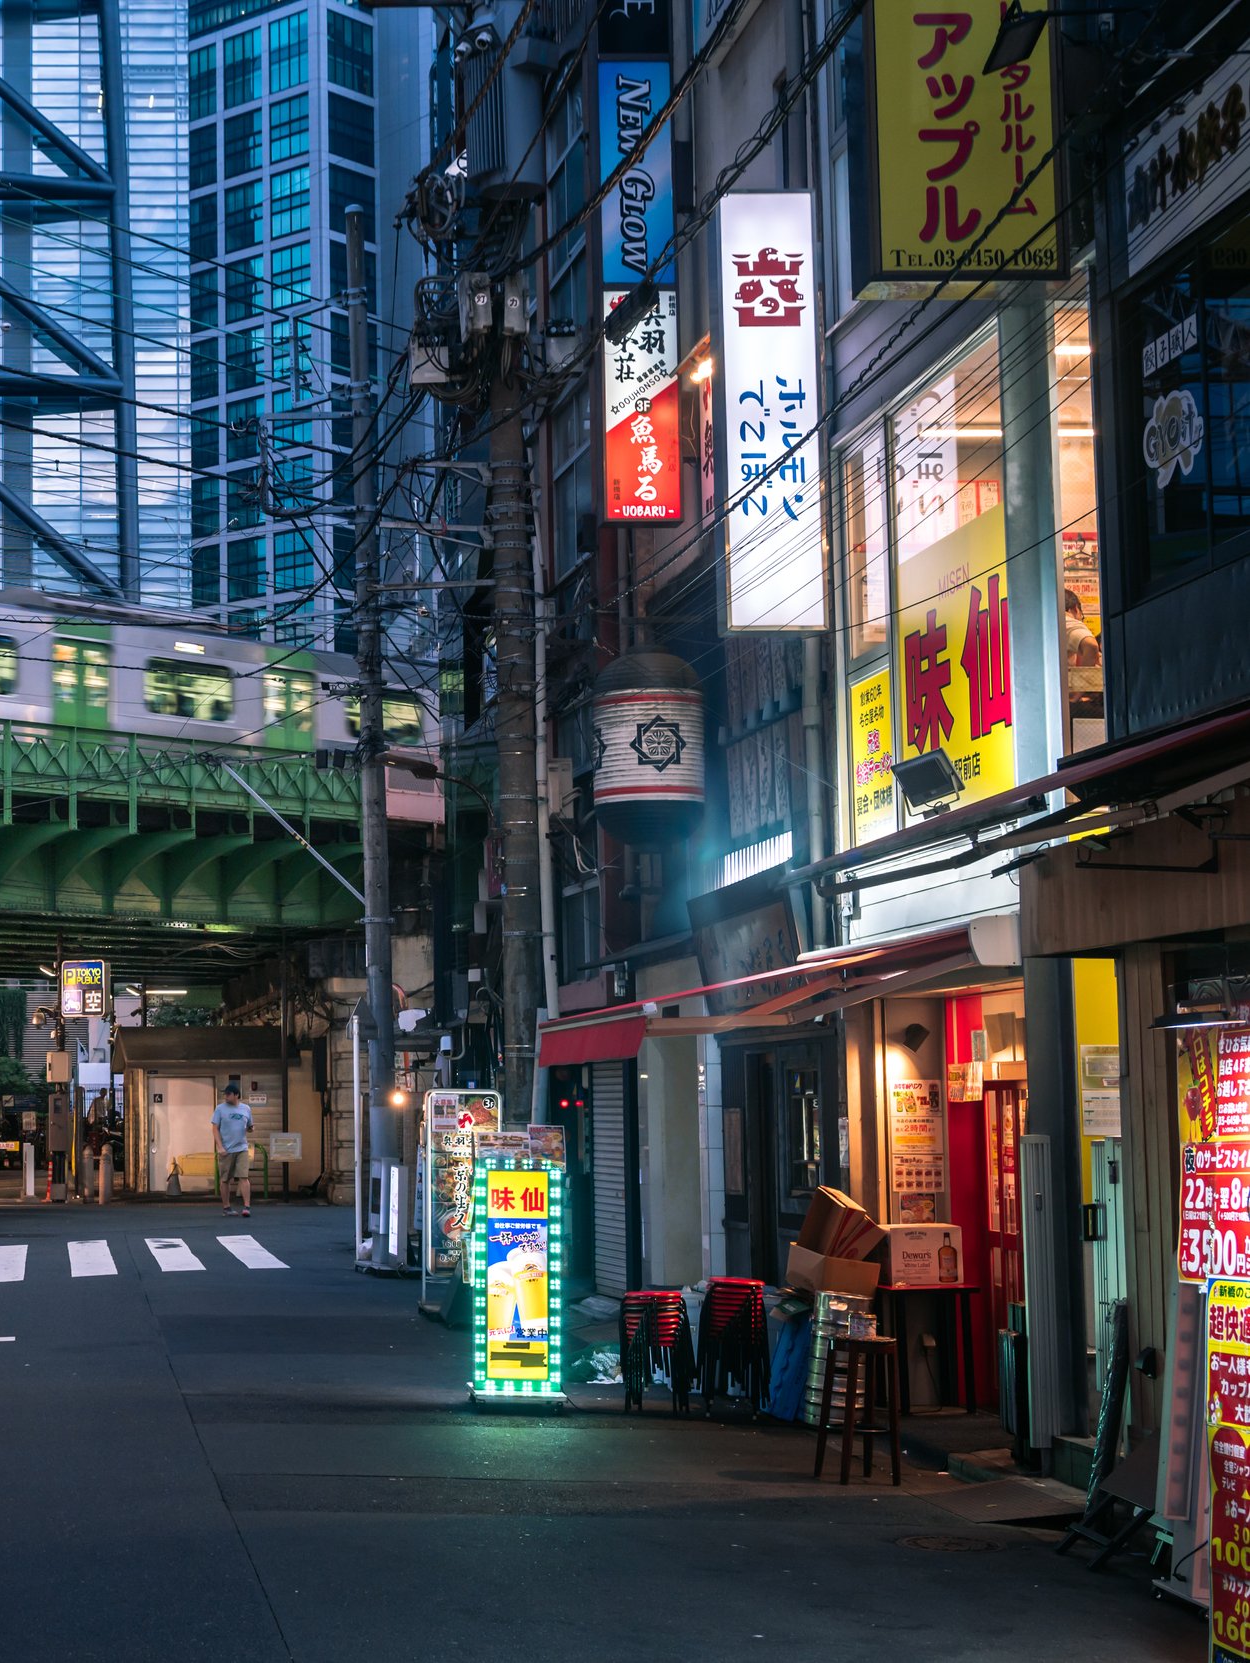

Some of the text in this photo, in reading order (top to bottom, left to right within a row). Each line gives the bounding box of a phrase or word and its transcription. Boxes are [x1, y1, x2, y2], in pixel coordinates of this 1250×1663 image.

[1000, 0, 1038, 216] タルルーム
[913, 13, 982, 243] アップル
[621, 167, 652, 272] GLOW
[890, 248, 1054, 268] TEL.0364501069
[636, 399, 651, 412] 3F
[739, 379, 773, 517] でこぼこ
[776, 374, 807, 522] ホルモン
[622, 505, 666, 517] UOBARU
[938, 562, 970, 600] MISEN
[904, 573, 1012, 755] 味仙
[951, 751, 981, 781] 駅前店
[76, 968, 102, 976] TOKYO
[76, 976, 102, 985] PUBLIC
[84, 990, 102, 1012] 空
[490, 1186, 545, 1213] 味仙
[902, 1250, 932, 1260] Dewar's
[515, 1328, 548, 1338] 営業中
[1221, 1476, 1237, 1492] テレビ
